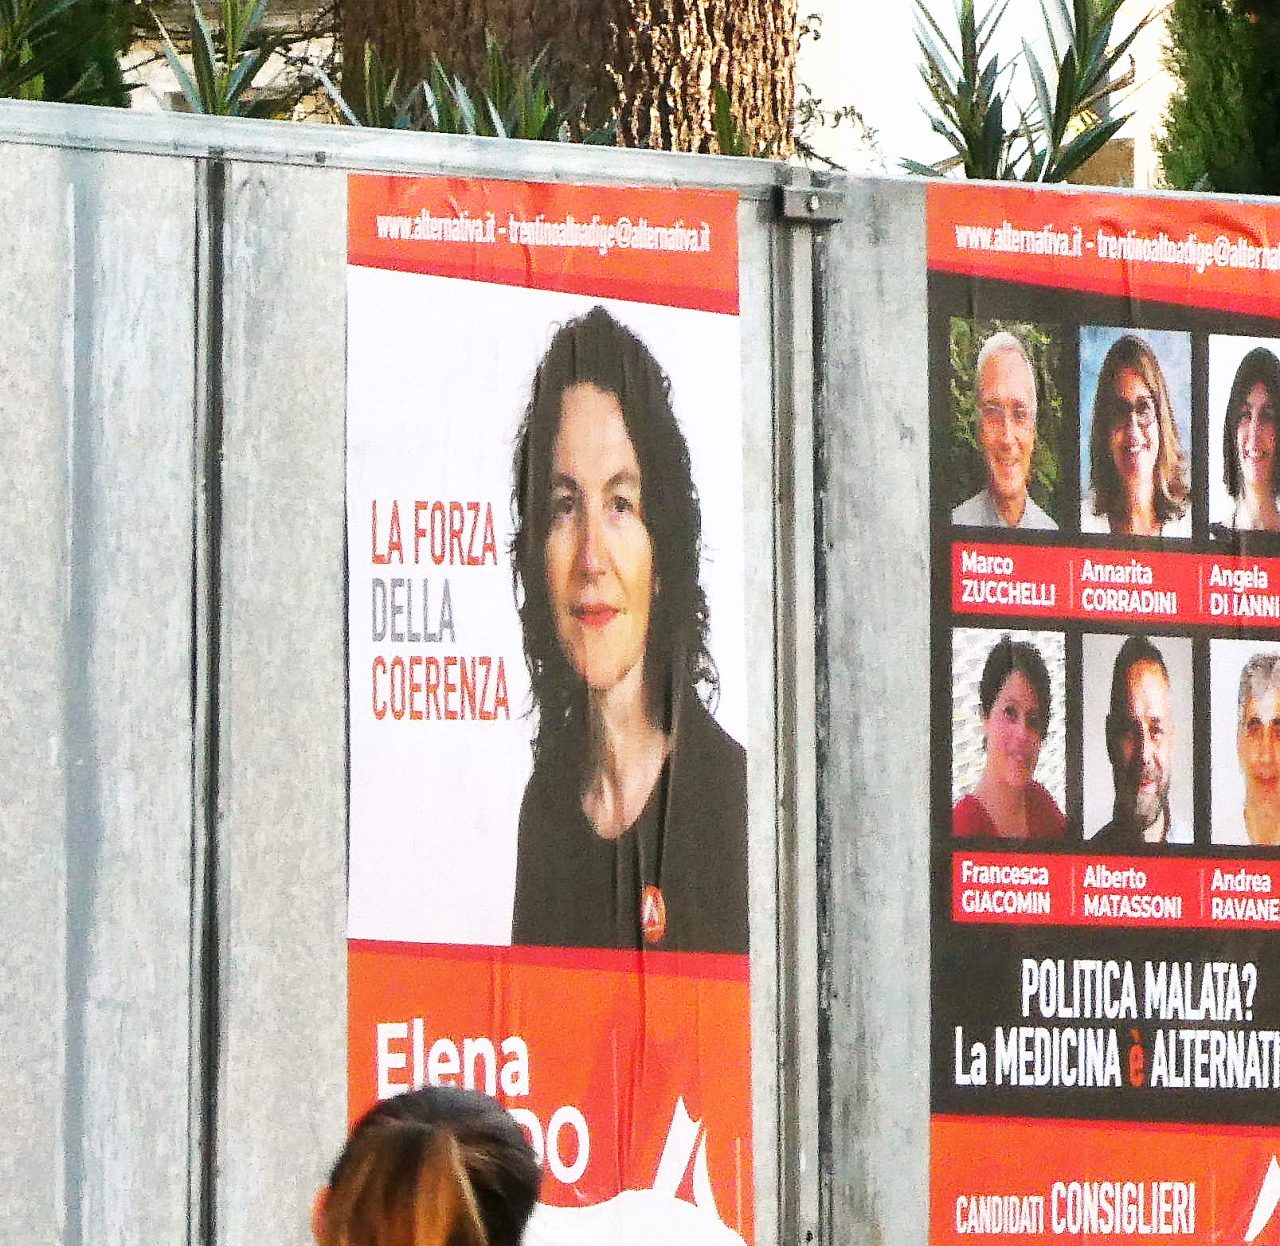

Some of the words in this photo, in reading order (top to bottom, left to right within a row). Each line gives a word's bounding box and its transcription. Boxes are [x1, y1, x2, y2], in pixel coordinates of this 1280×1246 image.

[377, 208, 496, 243] www.alternativa.it
[956, 220, 1082, 257] www.alternativa.it
[371, 500, 402, 565] LA
[415, 500, 498, 565] FORZA
[961, 550, 1013, 576] Marco
[1082, 560, 1153, 585] Annarita
[1209, 564, 1269, 591] Angela
[961, 580, 1056, 607] ZUCCHELLI
[1082, 588, 1178, 614] CORRADINI
[1209, 594, 1228, 617] DI
[1233, 595, 1280, 618] IANNI
[371, 577, 456, 643] DELLA
[371, 655, 511, 721] COERENZA
[961, 861, 1049, 886] Francesca
[1083, 864, 1147, 889] Alberto
[1211, 868, 1272, 892] Andrea
[961, 890, 1051, 914] GIACOMIN
[1083, 894, 1182, 919] MATASSONI
[1021, 958, 1137, 1019] POLITICA
[1144, 961, 1258, 1021] MALATA?
[375, 1018, 531, 1099] Elena
[954, 1026, 988, 1086] La
[995, 1027, 1123, 1088] MEDICINA
[1127, 1027, 1145, 1087] è
[955, 1194, 1044, 1234] CANDIDATI
[1050, 1181, 1196, 1235] CONSIGLIERI
